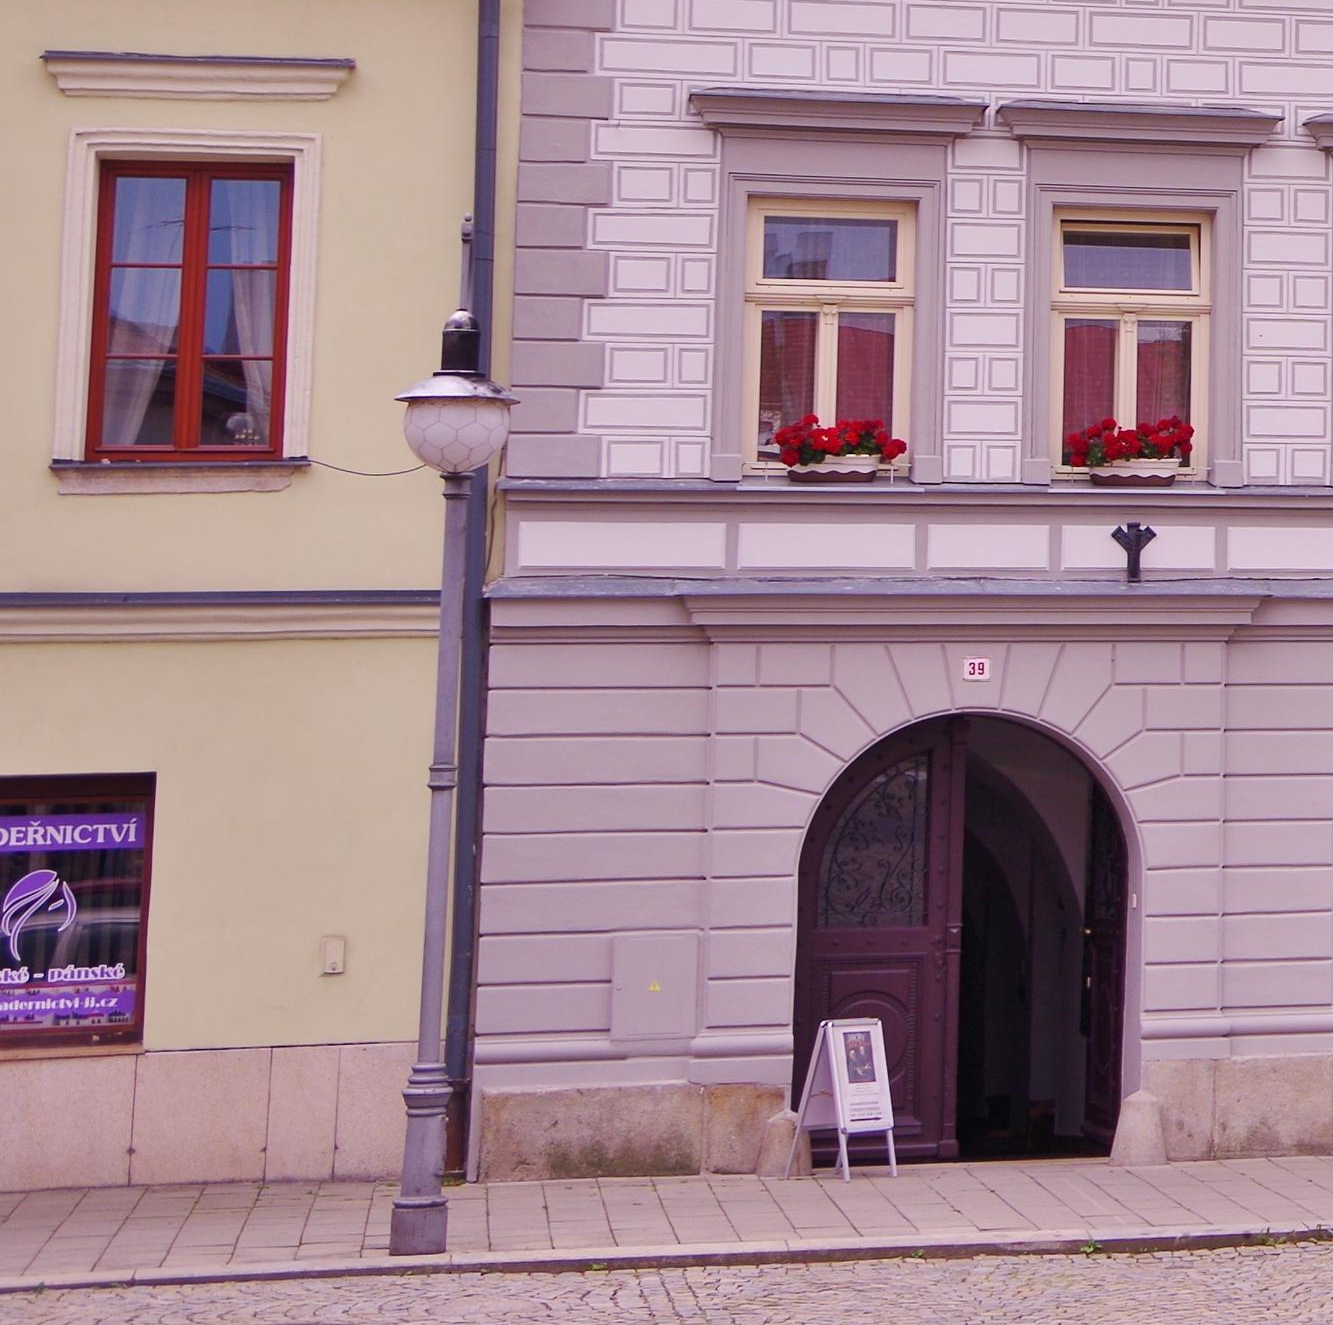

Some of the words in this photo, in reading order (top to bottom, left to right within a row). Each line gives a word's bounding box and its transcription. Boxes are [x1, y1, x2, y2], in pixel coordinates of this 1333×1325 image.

[968, 662, 985, 676] 39
[0, 966, 30, 984] ké
[48, 962, 126, 983] pánské
